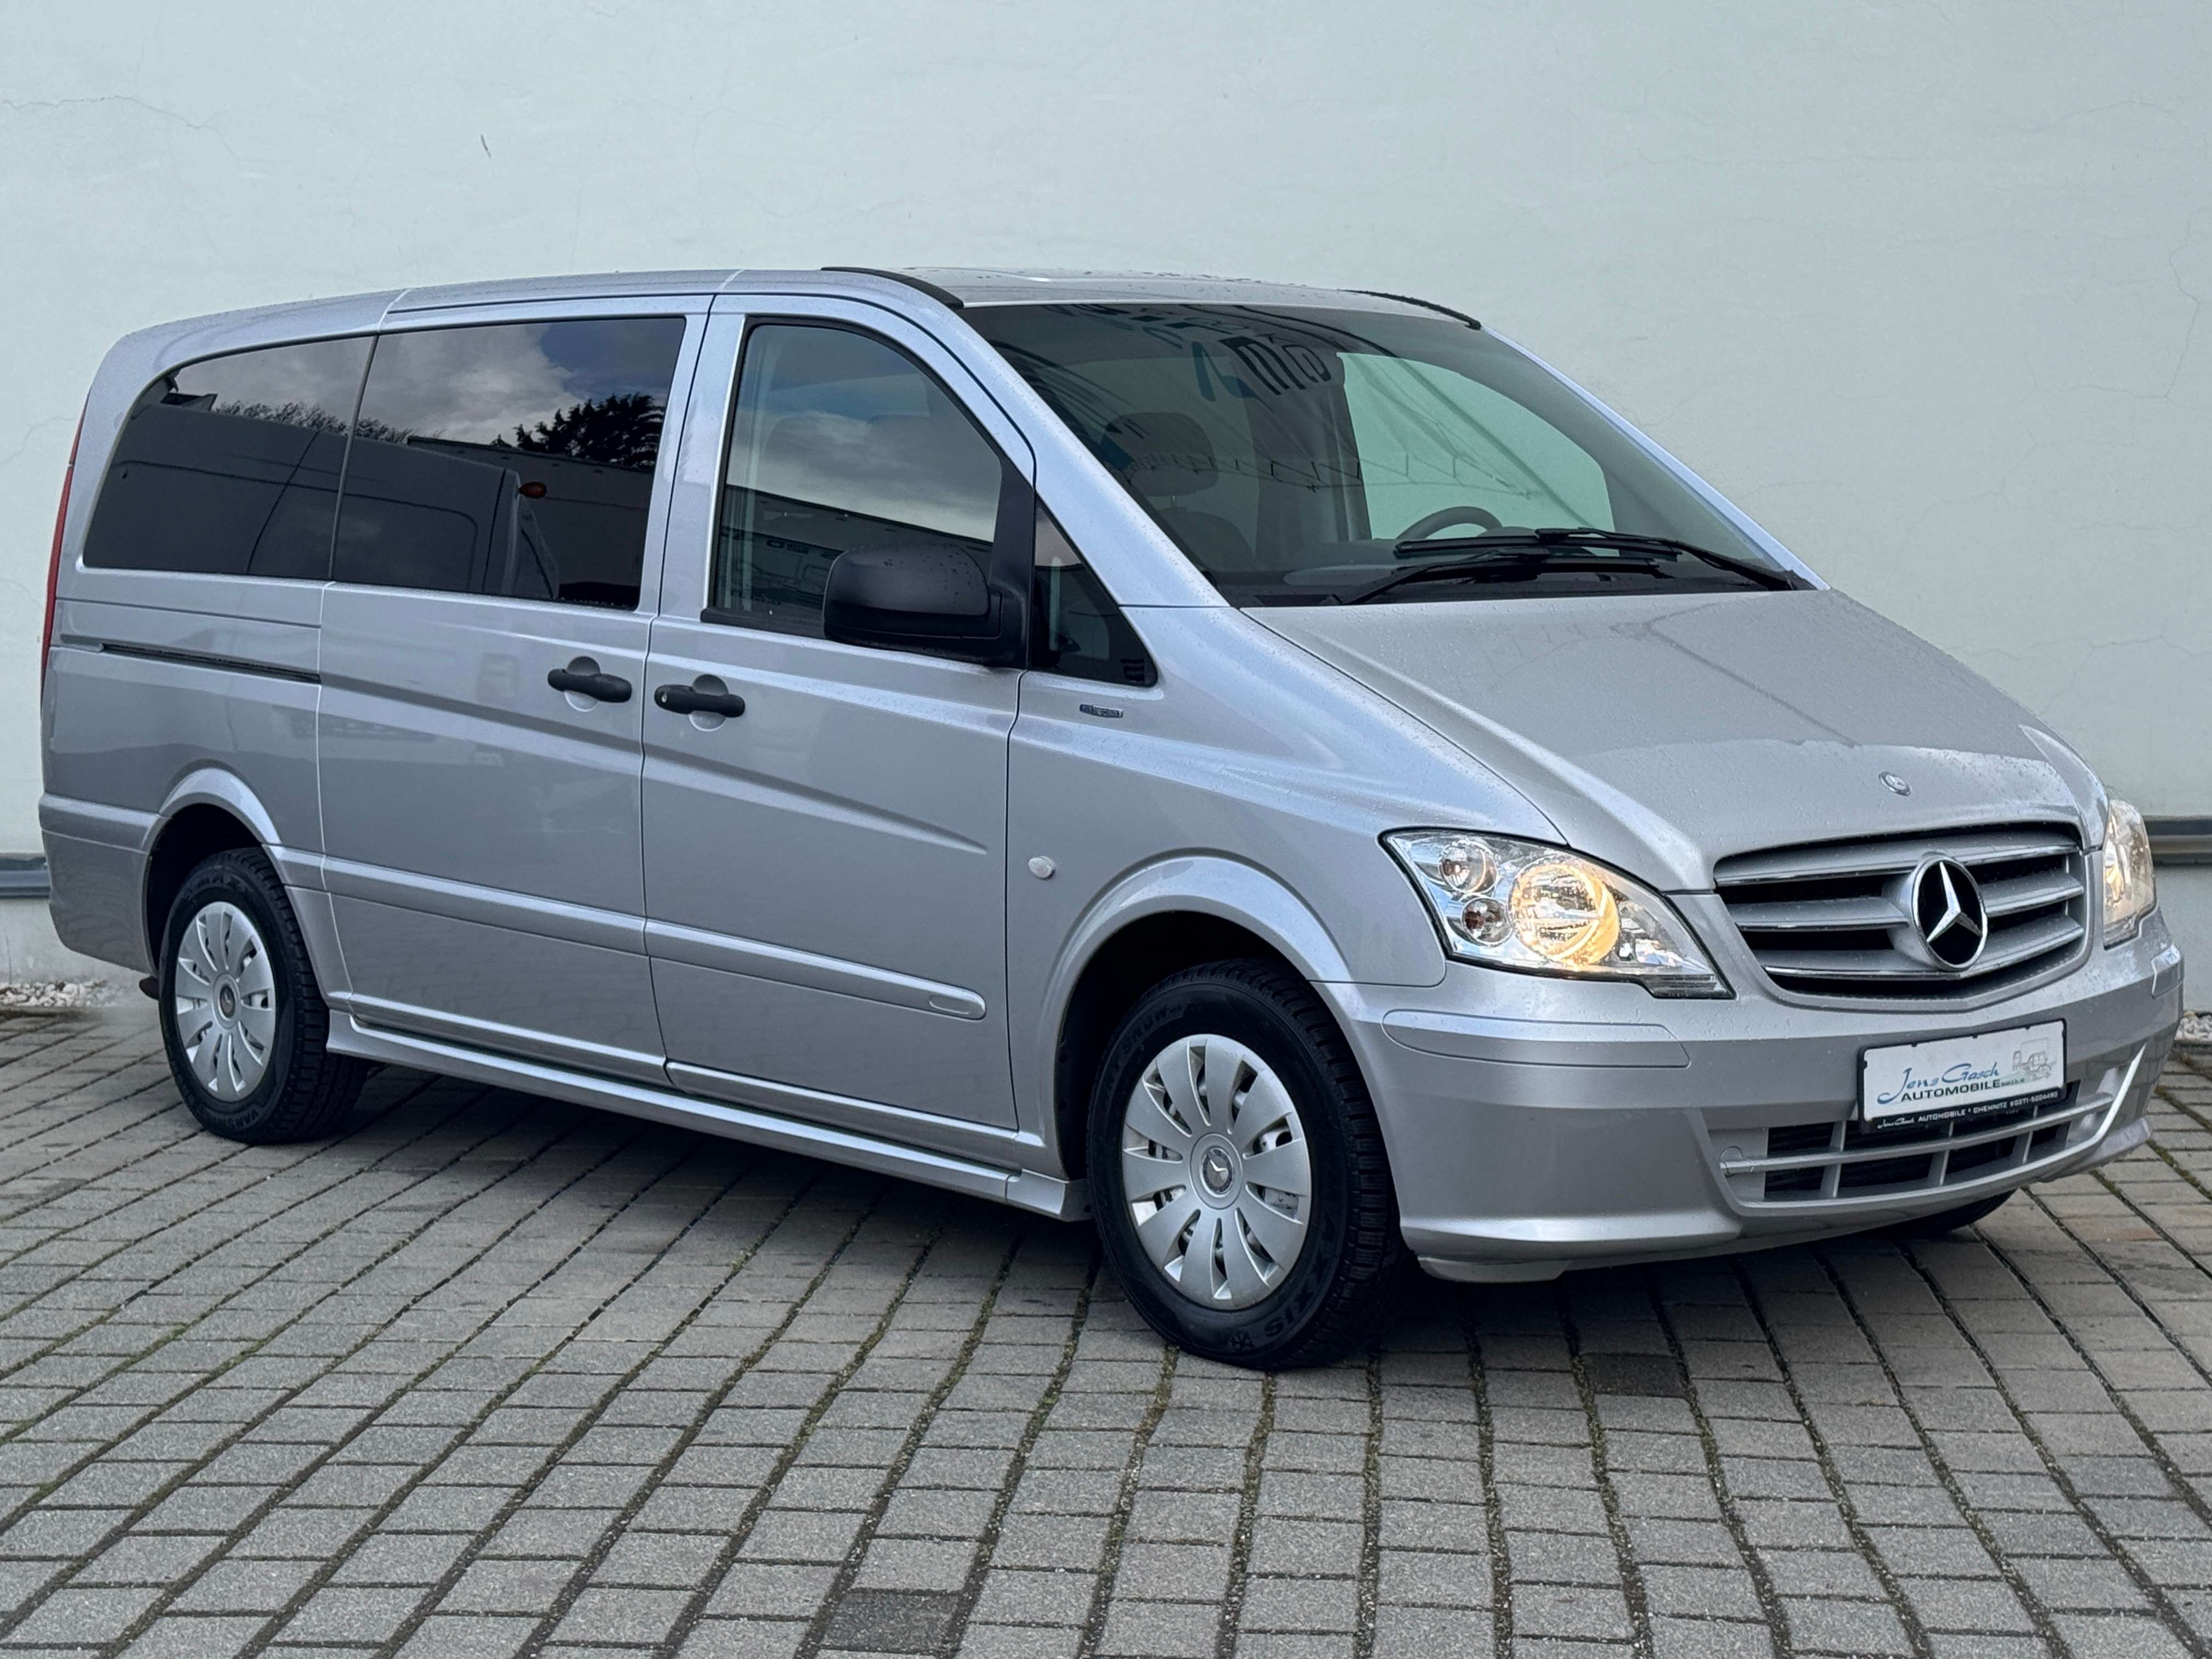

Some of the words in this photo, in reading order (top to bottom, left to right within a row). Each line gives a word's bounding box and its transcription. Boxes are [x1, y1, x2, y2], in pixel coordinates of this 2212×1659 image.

[1877, 1067, 1939, 1104] Jens
[1941, 1062, 2000, 1084] Gasch
[1901, 1078, 2001, 1102] AUTOMOBILE
[1917, 1109, 1966, 1122] AUTOMOBILE
[1973, 1101, 2007, 1114] CHEMNITZ
